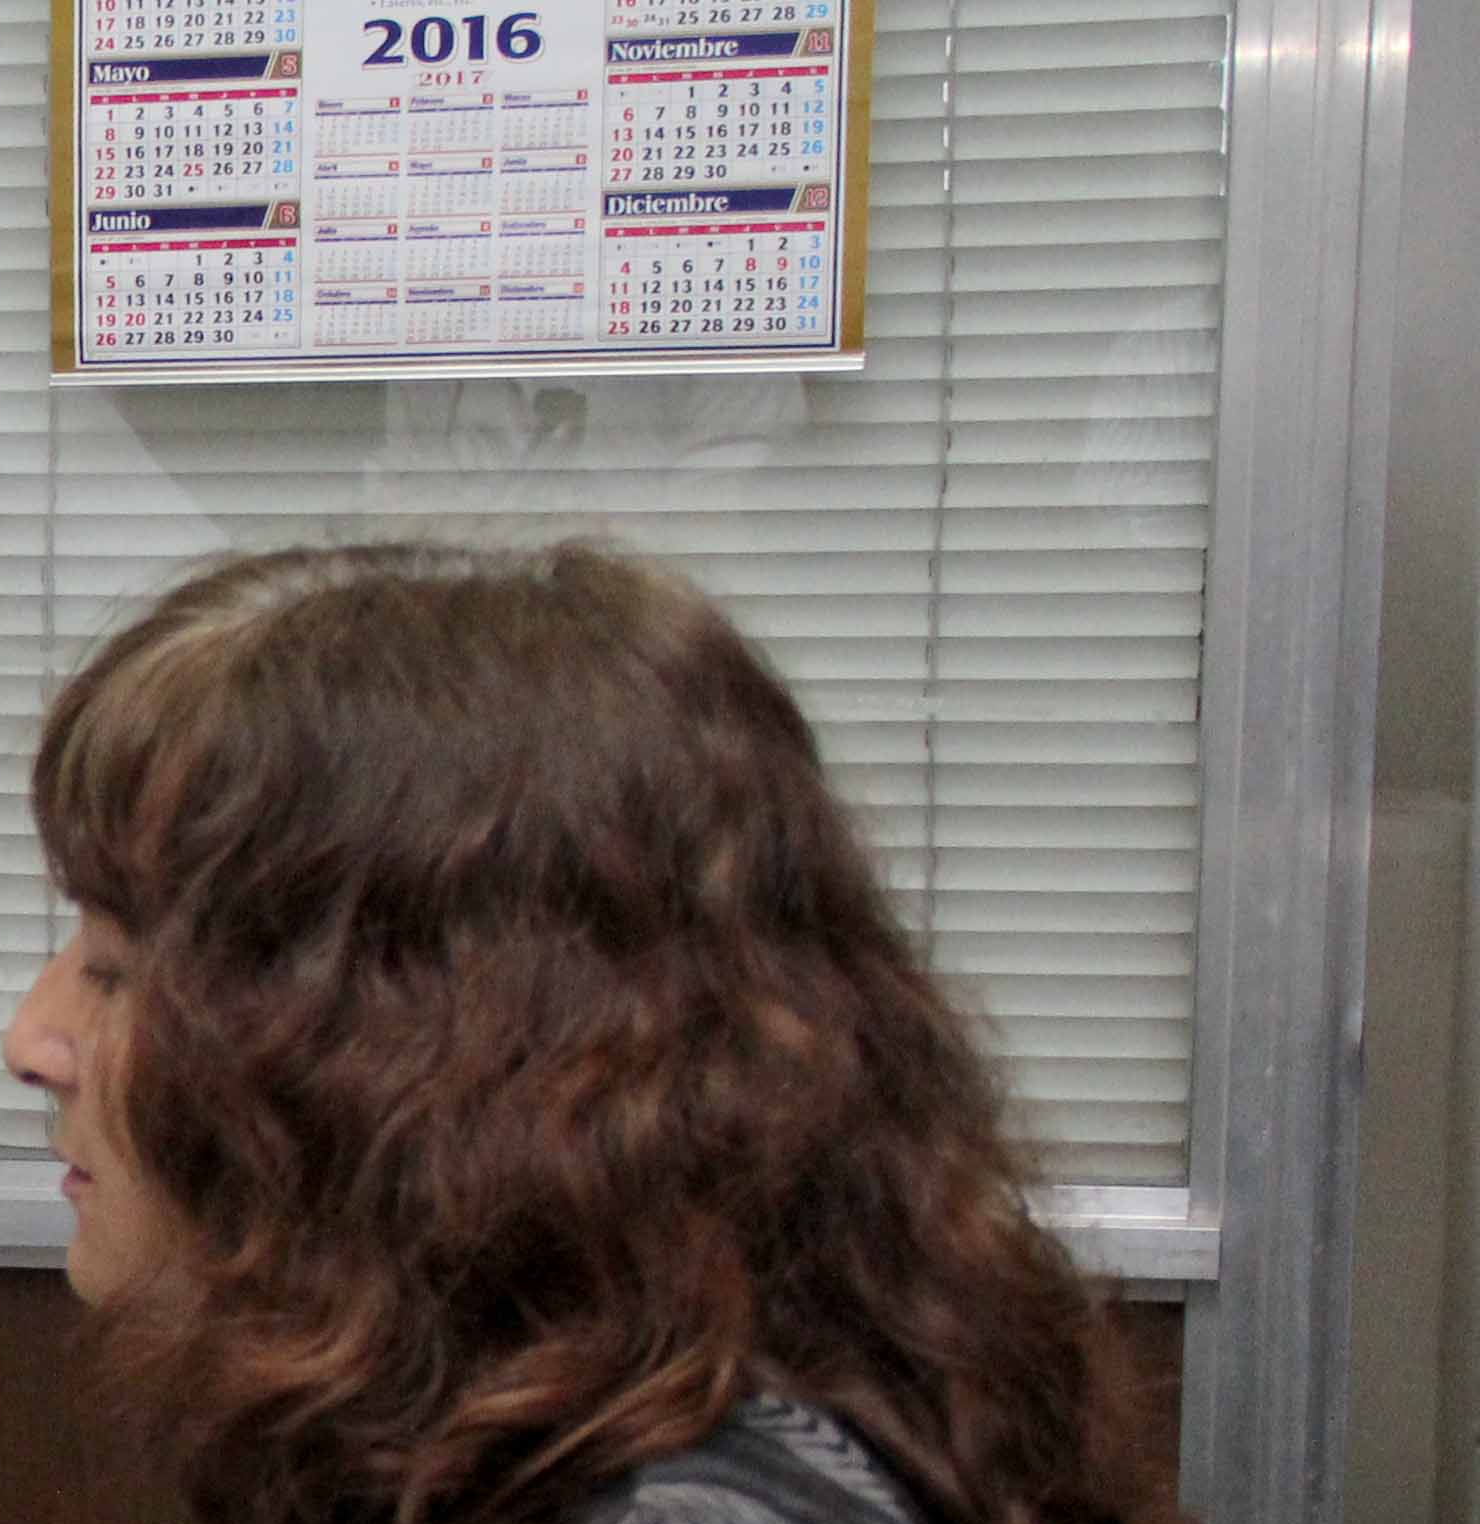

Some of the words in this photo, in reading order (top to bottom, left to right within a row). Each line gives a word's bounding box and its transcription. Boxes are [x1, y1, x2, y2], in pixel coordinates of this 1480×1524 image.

[96, 17, 116, 32] 17
[125, 15, 146, 30] 18
[156, 14, 176, 29] 19
[183, 13, 205, 28] 20
[213, 11, 233, 26] 21
[244, 10, 265, 25] 22
[677, 10, 699, 25] 25
[708, 8, 732, 24] 26
[740, 7, 763, 22] 27
[772, 5, 796, 21] 28
[94, 37, 115, 51] 24
[124, 35, 145, 50] 25
[153, 34, 175, 48] 26
[183, 32, 205, 47] 27
[213, 31, 235, 46] 28
[244, 29, 265, 45] 29
[361, 12, 542, 66] 2016
[610, 37, 739, 62] Noviembre
[92, 65, 151, 85] Mayo
[418, 69, 486, 87] 2017
[688, 85, 695, 99] 1
[718, 83, 729, 98] 2
[750, 82, 761, 97] 3
[780, 81, 793, 95] 4
[106, 109, 114, 123] 1
[135, 106, 145, 121] 2
[164, 105, 174, 121] 3
[193, 104, 204, 118] 4
[223, 103, 234, 118] 5
[253, 101, 264, 116] 6
[623, 107, 635, 122] 6
[655, 106, 666, 121] 7
[685, 104, 697, 121] 8
[717, 103, 729, 118] 9
[739, 102, 761, 117] 10
[771, 101, 790, 116] 11
[104, 127, 116, 142] 8
[134, 126, 145, 140] 9
[154, 125, 175, 140] 10
[184, 124, 201, 138] 11
[213, 122, 233, 137] 12
[244, 121, 263, 137] 13
[613, 127, 634, 142] 13
[645, 126, 665, 141] 14
[675, 125, 697, 140] 15
[707, 123, 728, 139] 16
[738, 122, 760, 137] 17
[771, 121, 792, 137] 18
[96, 146, 116, 161] 15
[125, 145, 145, 160] 16
[154, 144, 174, 159] 17
[184, 143, 205, 158] 18
[214, 142, 234, 156] 19
[242, 141, 264, 156] 20
[611, 147, 634, 162] 20
[642, 146, 663, 161] 21
[673, 145, 696, 160] 22
[704, 143, 727, 159] 23
[736, 143, 759, 158] 24
[768, 141, 791, 156] 25
[95, 166, 115, 181] 22
[124, 164, 145, 179] 23
[154, 164, 175, 178] 24
[183, 162, 204, 177] 25
[213, 161, 234, 176] 26
[242, 160, 263, 175] 27
[610, 167, 633, 183] 27
[641, 166, 665, 182] 28
[672, 165, 696, 180] 29
[704, 164, 727, 179] 30
[95, 185, 116, 200] 29
[124, 184, 146, 199] 30
[153, 183, 173, 198] 31
[607, 193, 730, 215] Diciembre
[90, 211, 152, 231] Junio
[747, 237, 755, 253] 1
[778, 236, 789, 251] 2
[195, 253, 202, 267] 1
[223, 252, 234, 266] 2
[253, 251, 264, 266] 3
[283, 250, 294, 263] 4
[620, 261, 631, 275] 4
[652, 260, 663, 275] 5
[682, 259, 694, 274] 6
[714, 257, 725, 273] 7
[745, 257, 757, 272] 8
[776, 256, 789, 272] 9
[106, 275, 116, 290] 5
[135, 274, 146, 289] 6
[165, 273, 174, 288] 7
[193, 272, 205, 287] 8
[223, 271, 234, 286] 9
[244, 270, 264, 285] 10
[610, 281, 629, 296] 11
[642, 279, 661, 295] 12
[672, 278, 693, 294] 13
[704, 278, 725, 293] 14
[735, 277, 756, 292] 15
[767, 276, 788, 292] 16
[97, 294, 116, 308] 12
[126, 293, 146, 307] 13
[155, 292, 175, 306] 14
[185, 291, 205, 306] 15
[215, 290, 234, 305] 16
[244, 289, 264, 304] 17
[610, 300, 631, 315] 18
[641, 299, 662, 314] 19
[670, 298, 693, 314] 20
[701, 298, 722, 313] 21
[733, 297, 755, 312] 22
[764, 295, 787, 312] 23
[97, 313, 117, 328] 19
[125, 312, 146, 327] 20
[153, 311, 173, 326] 21
[183, 310, 204, 325] 22
[213, 309, 234, 324] 23
[242, 309, 264, 323] 24
[607, 321, 630, 336] 25
[639, 319, 661, 334] 26
[669, 319, 692, 334] 27
[701, 318, 724, 333] 28
[732, 317, 755, 332] 29
[763, 316, 787, 332] 30
[95, 332, 117, 347] 26
[125, 331, 145, 346] 27
[154, 330, 176, 345] 28
[183, 330, 205, 344] 29
[213, 329, 235, 344] 30
